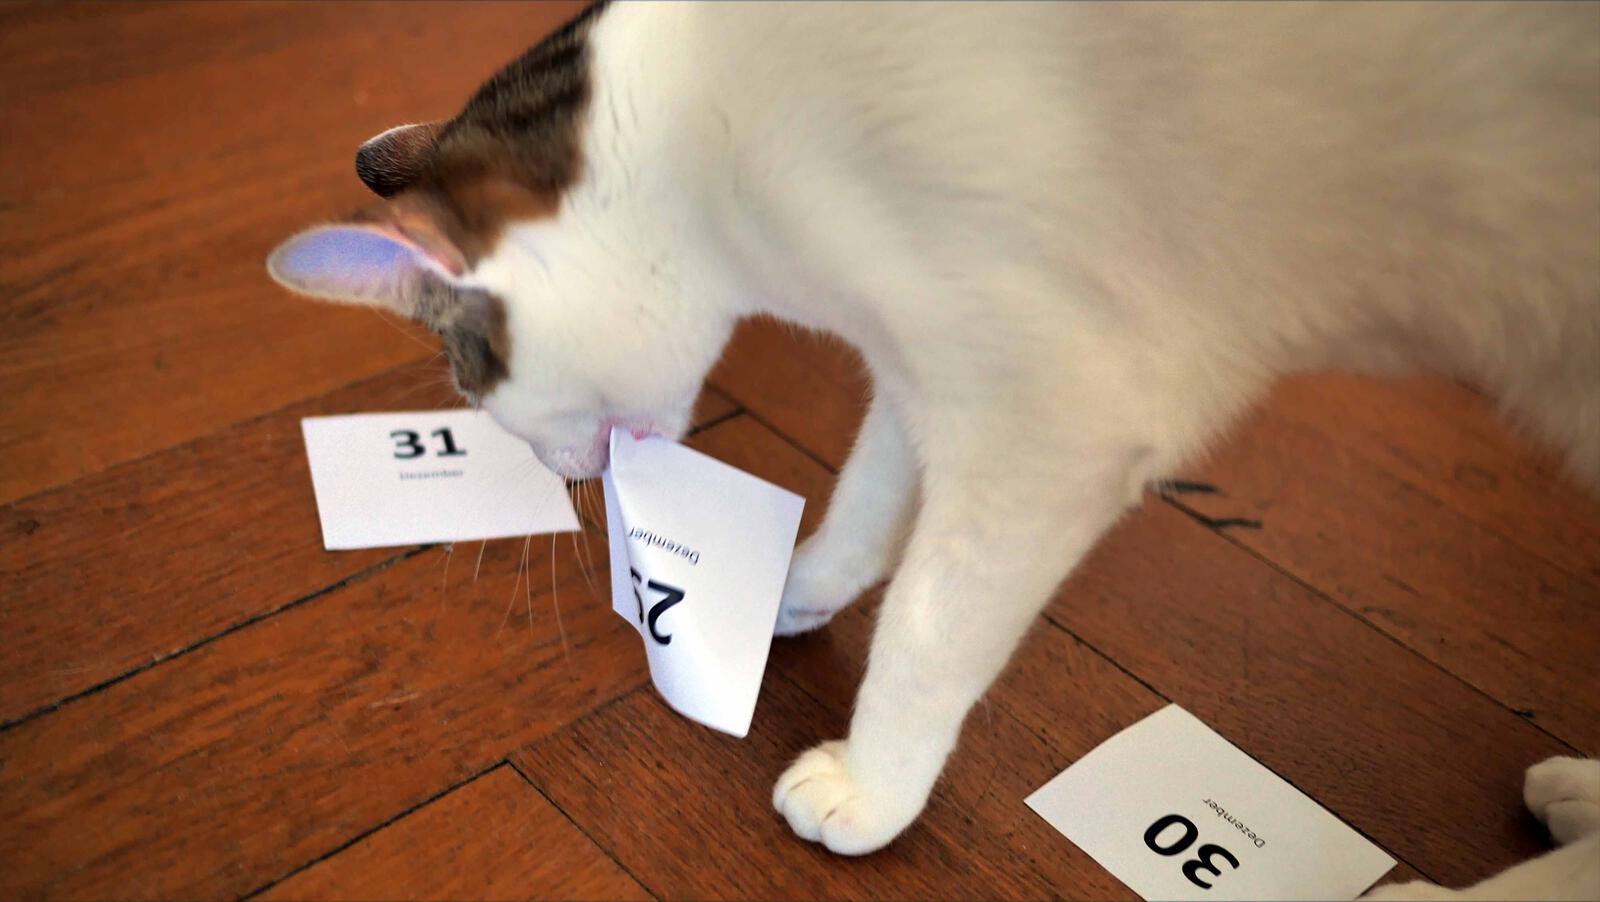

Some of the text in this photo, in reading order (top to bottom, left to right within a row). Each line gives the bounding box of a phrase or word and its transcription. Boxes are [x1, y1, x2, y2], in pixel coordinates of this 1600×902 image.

[390, 426, 468, 460] 31
[629, 526, 700, 566] Dezember
[1202, 798, 1266, 848] Dezember
[1143, 814, 1240, 890] 30
